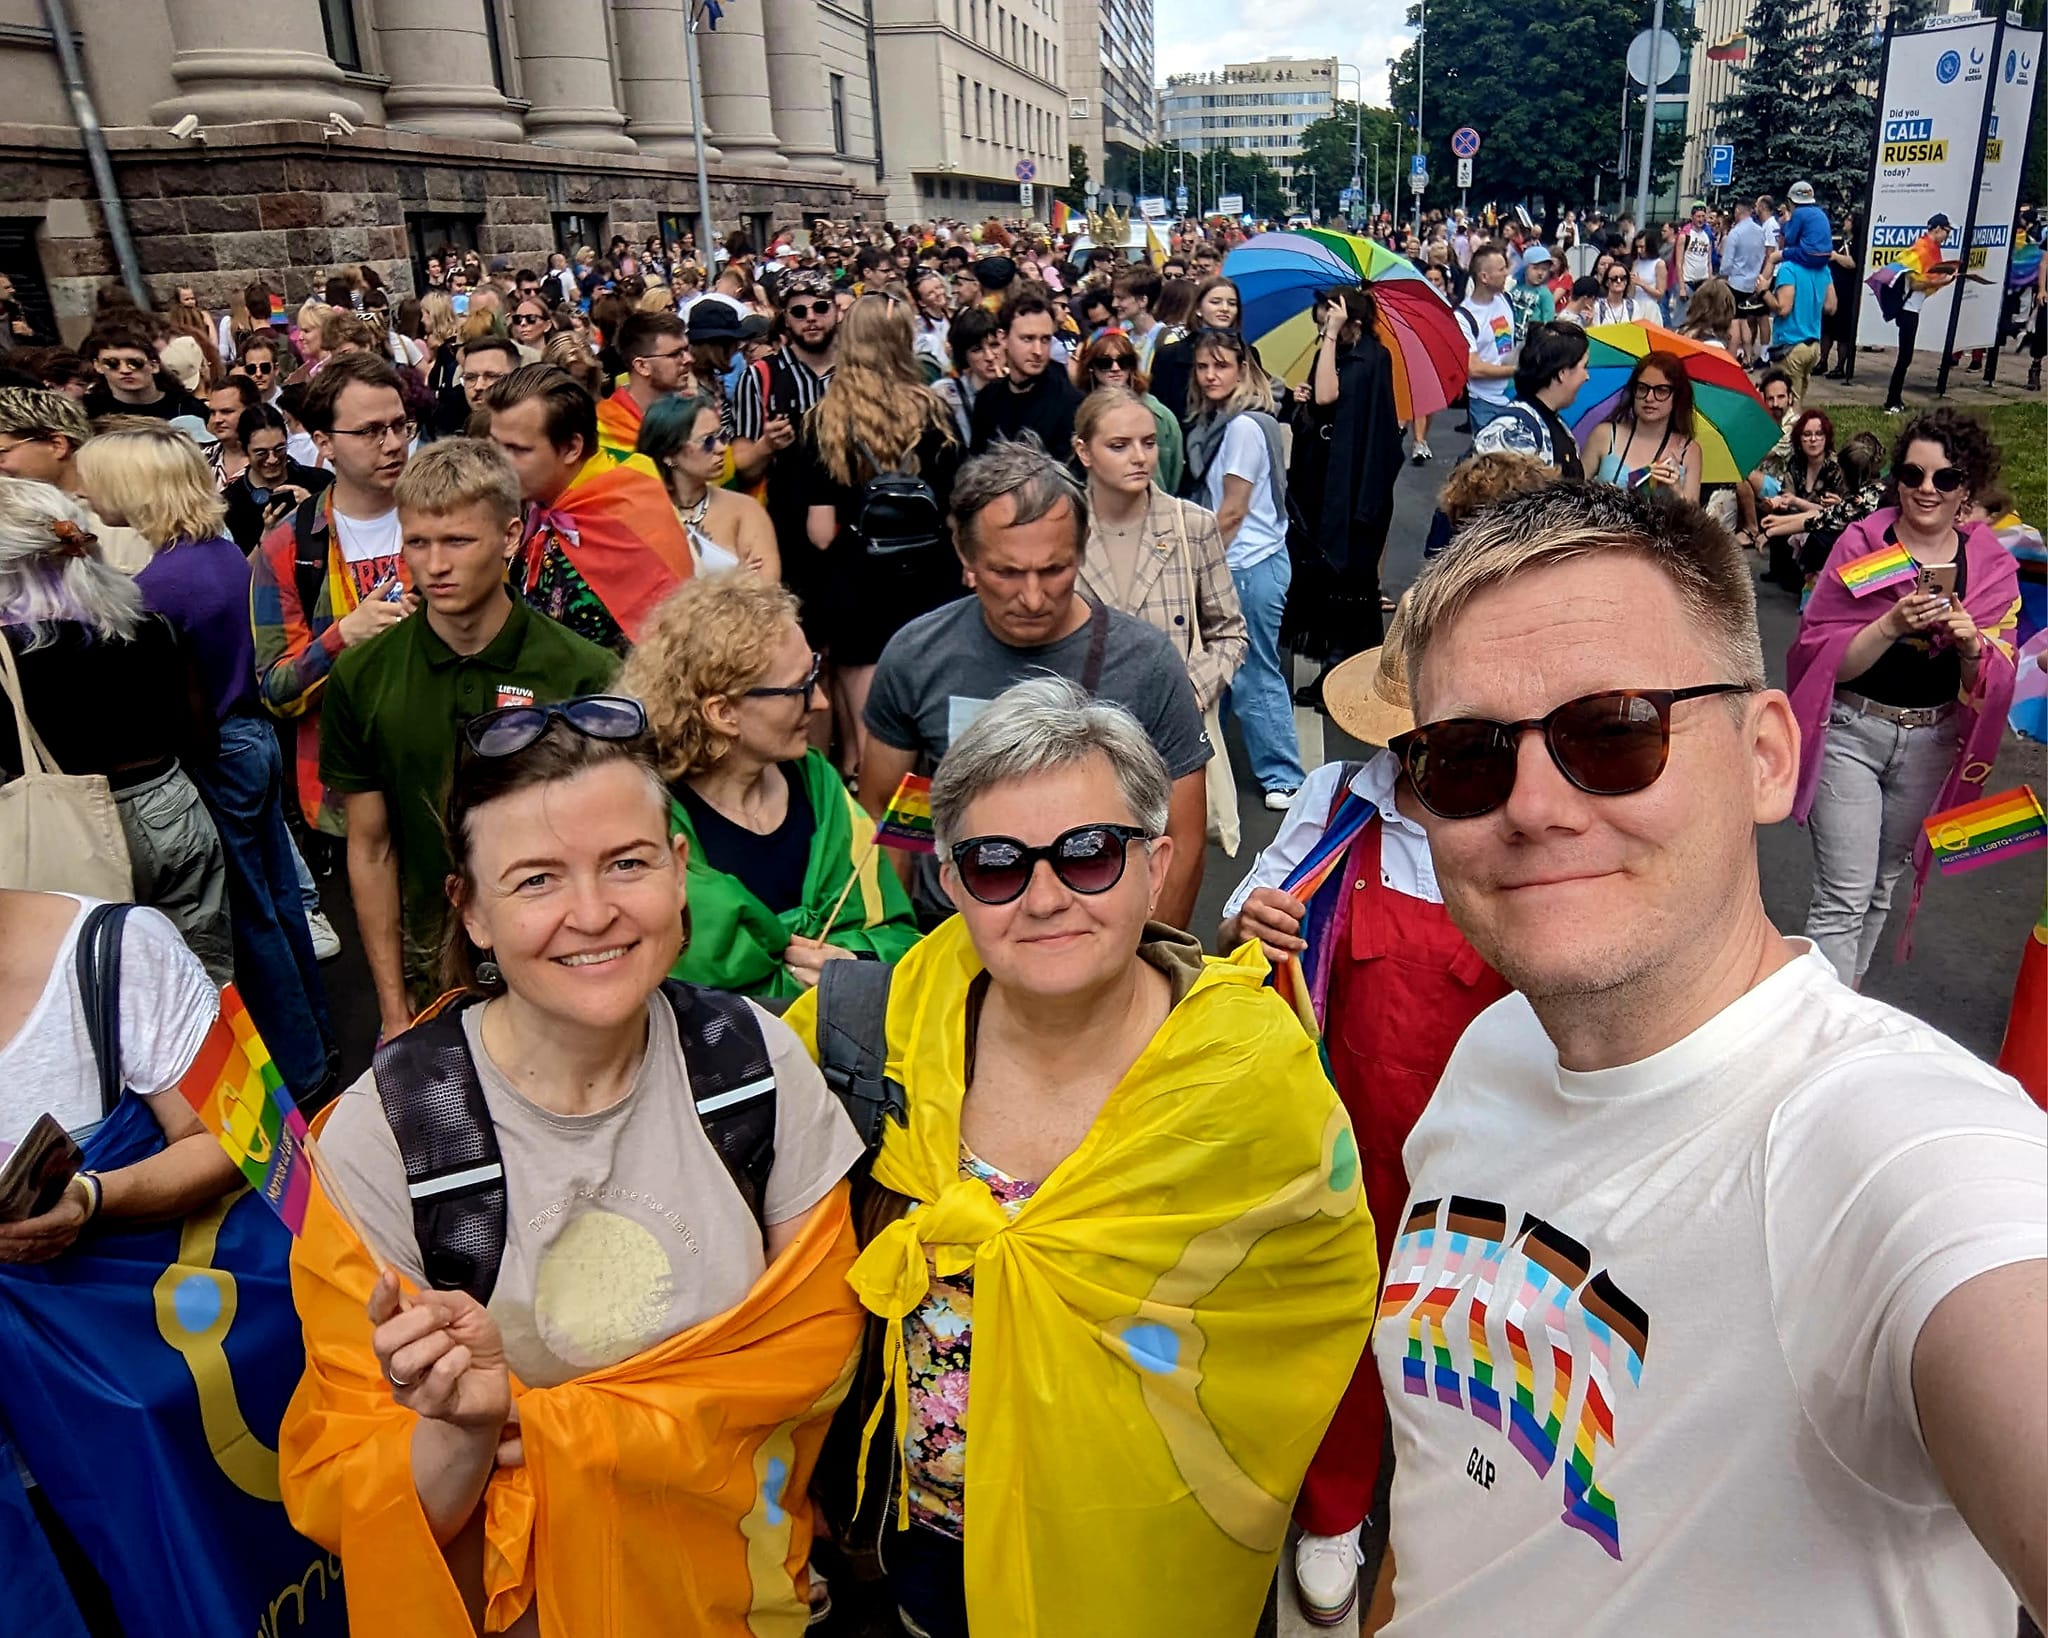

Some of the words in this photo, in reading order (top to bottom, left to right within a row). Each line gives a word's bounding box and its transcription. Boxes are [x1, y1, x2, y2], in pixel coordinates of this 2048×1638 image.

[1936, 16, 1952, 26] Clear
[1889, 108, 1904, 118] Did
[1905, 109, 1920, 119] you
[1886, 121, 1928, 141] CALL
[1713, 148, 1728, 168] P
[1884, 143, 1944, 163] RUSSIA
[1883, 167, 1911, 178] today?
[1876, 214, 1887, 223] Ar
[498, 684, 534, 699] LIETUVA
[1982, 839, 2013, 852] LGBTQ+
[1466, 1446, 1496, 1491] GAP
